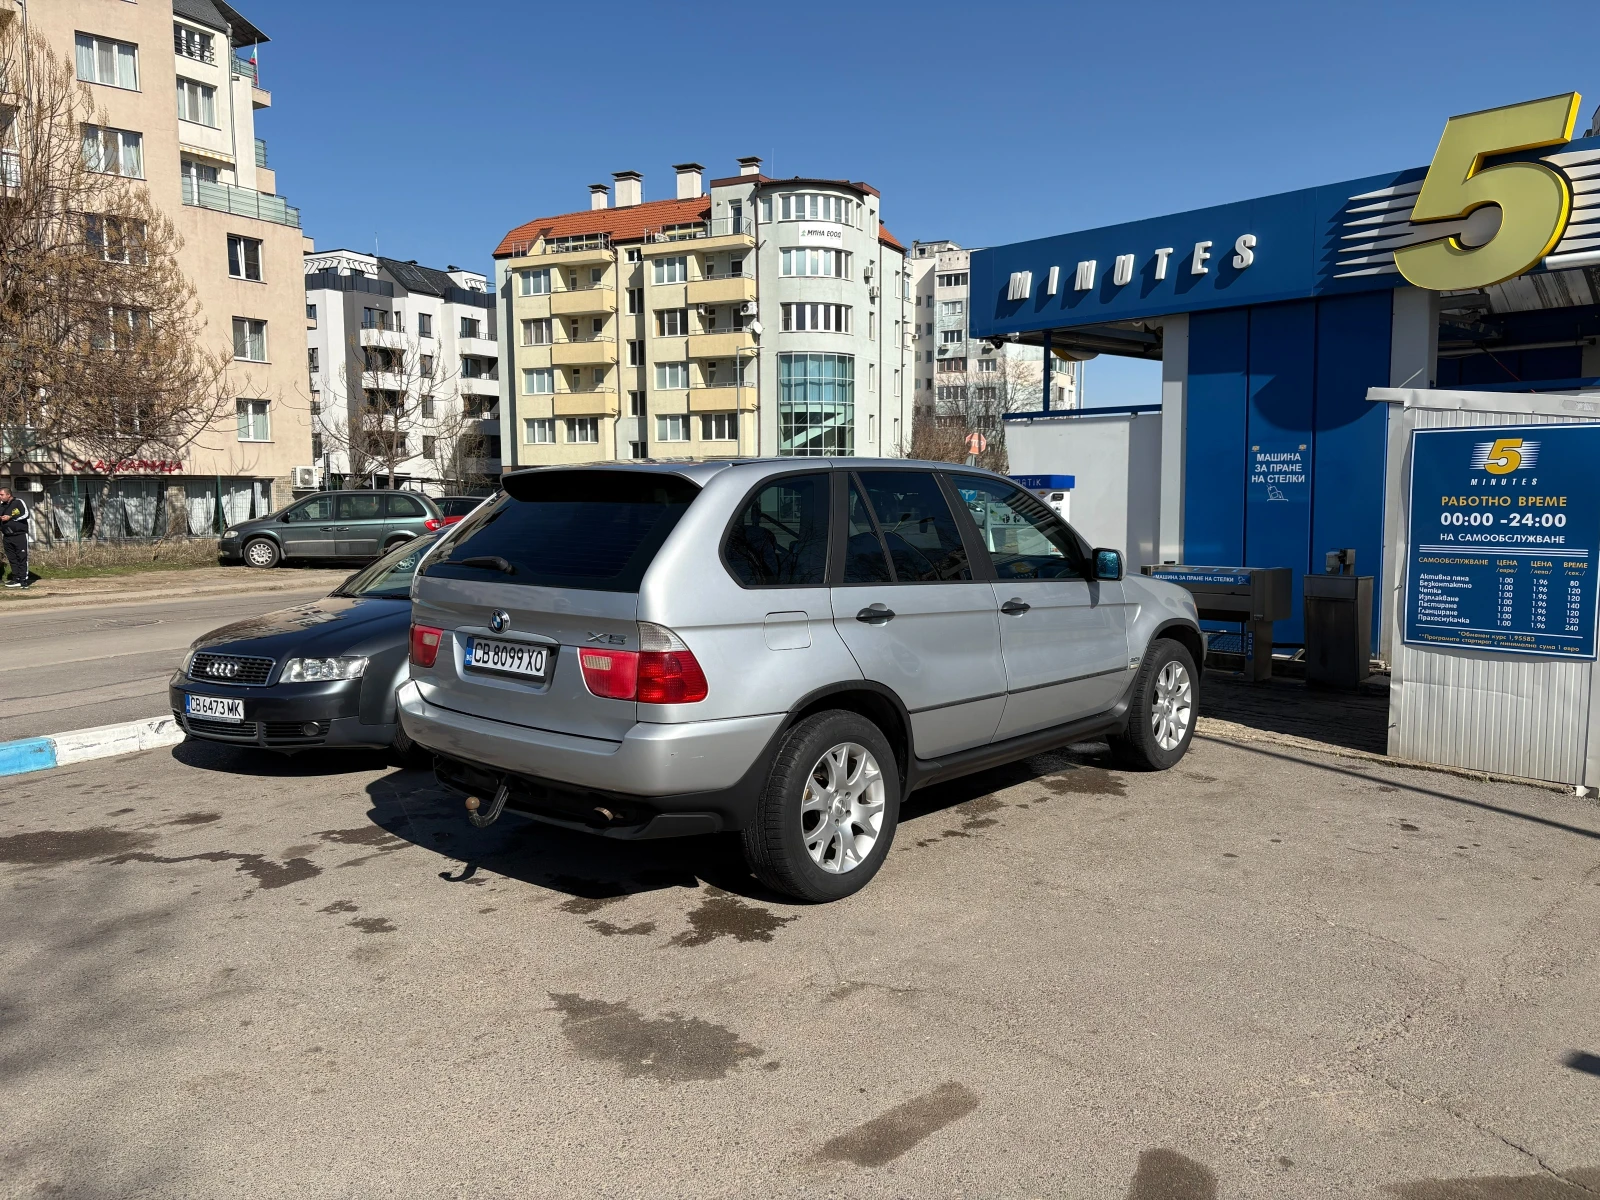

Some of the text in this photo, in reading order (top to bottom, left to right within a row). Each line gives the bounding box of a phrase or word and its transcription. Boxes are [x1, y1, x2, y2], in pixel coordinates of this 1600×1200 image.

[1393, 91, 1582, 291] 5
[1007, 233, 1257, 300] MINUTES
[1256, 453, 1301, 461] МАШИНА
[1484, 438, 1523, 475] 5
[1255, 464, 1302, 472] ЗА ПРАНЕ
[1441, 496, 1567, 507] РАБОТНО ВРЕМЕ
[1440, 512, 1494, 526] 00:00
[1440, 533, 1565, 543] НА САМООБСЛУЖВАНЕ
[1418, 557, 1488, 565] САМООБСЛУЖВАНЕ
[1420, 580, 1472, 588] Безконтактно
[586, 632, 628, 645] X5
[474, 642, 490, 664] CB
[493, 647, 524, 669] 8099
[525, 650, 543, 672] XO
[190, 698, 241, 717] CB 6473 MK
